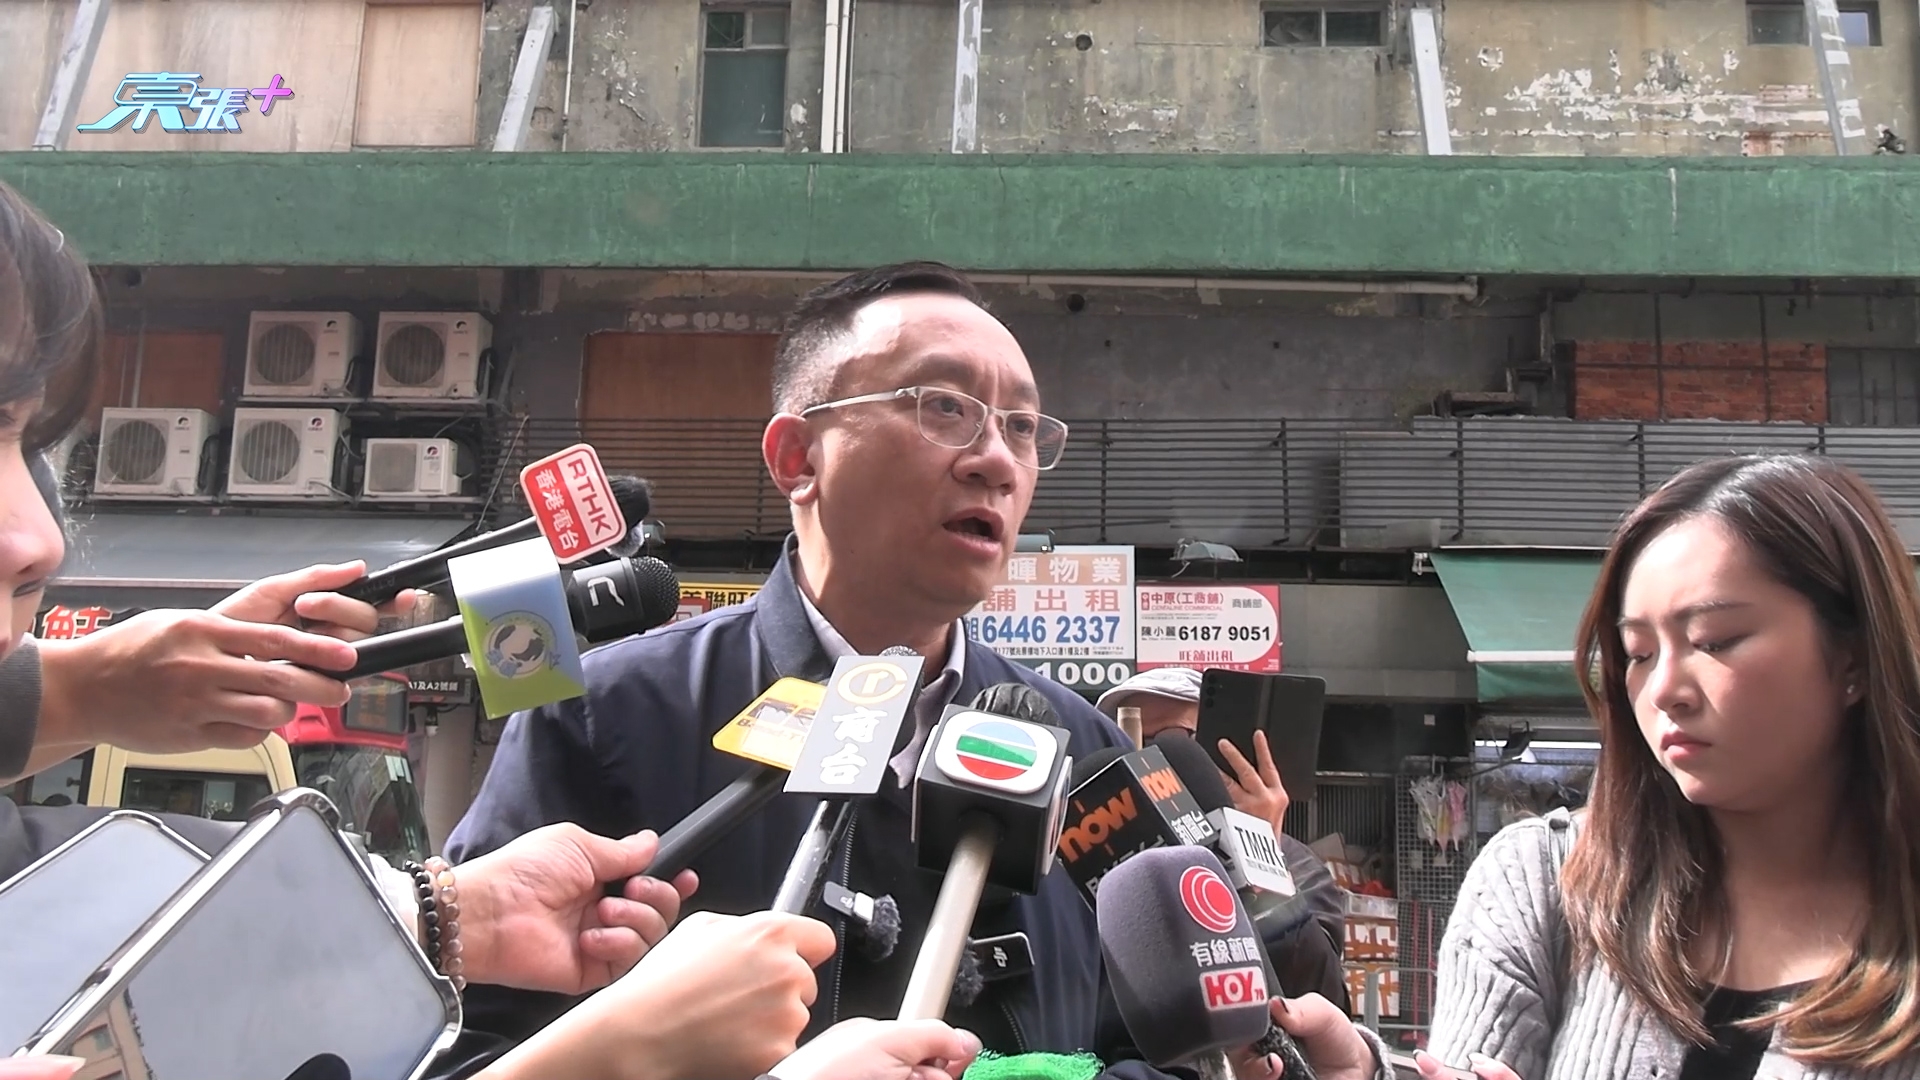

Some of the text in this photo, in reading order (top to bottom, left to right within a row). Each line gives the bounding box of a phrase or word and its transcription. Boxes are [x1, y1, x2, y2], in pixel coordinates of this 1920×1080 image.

[534, 469, 580, 550] 香港電台
[567, 458, 613, 535] RTHK
[982, 615, 1047, 643] 6446
[1055, 615, 1121, 643] 2337
[1179, 625, 1222, 641] 6187
[1228, 625, 1270, 641] 9051
[1034, 661, 1131, 686] 1000
[1140, 766, 1183, 803] now
[1058, 786, 1138, 864] now
[1204, 970, 1254, 1008] HOY
